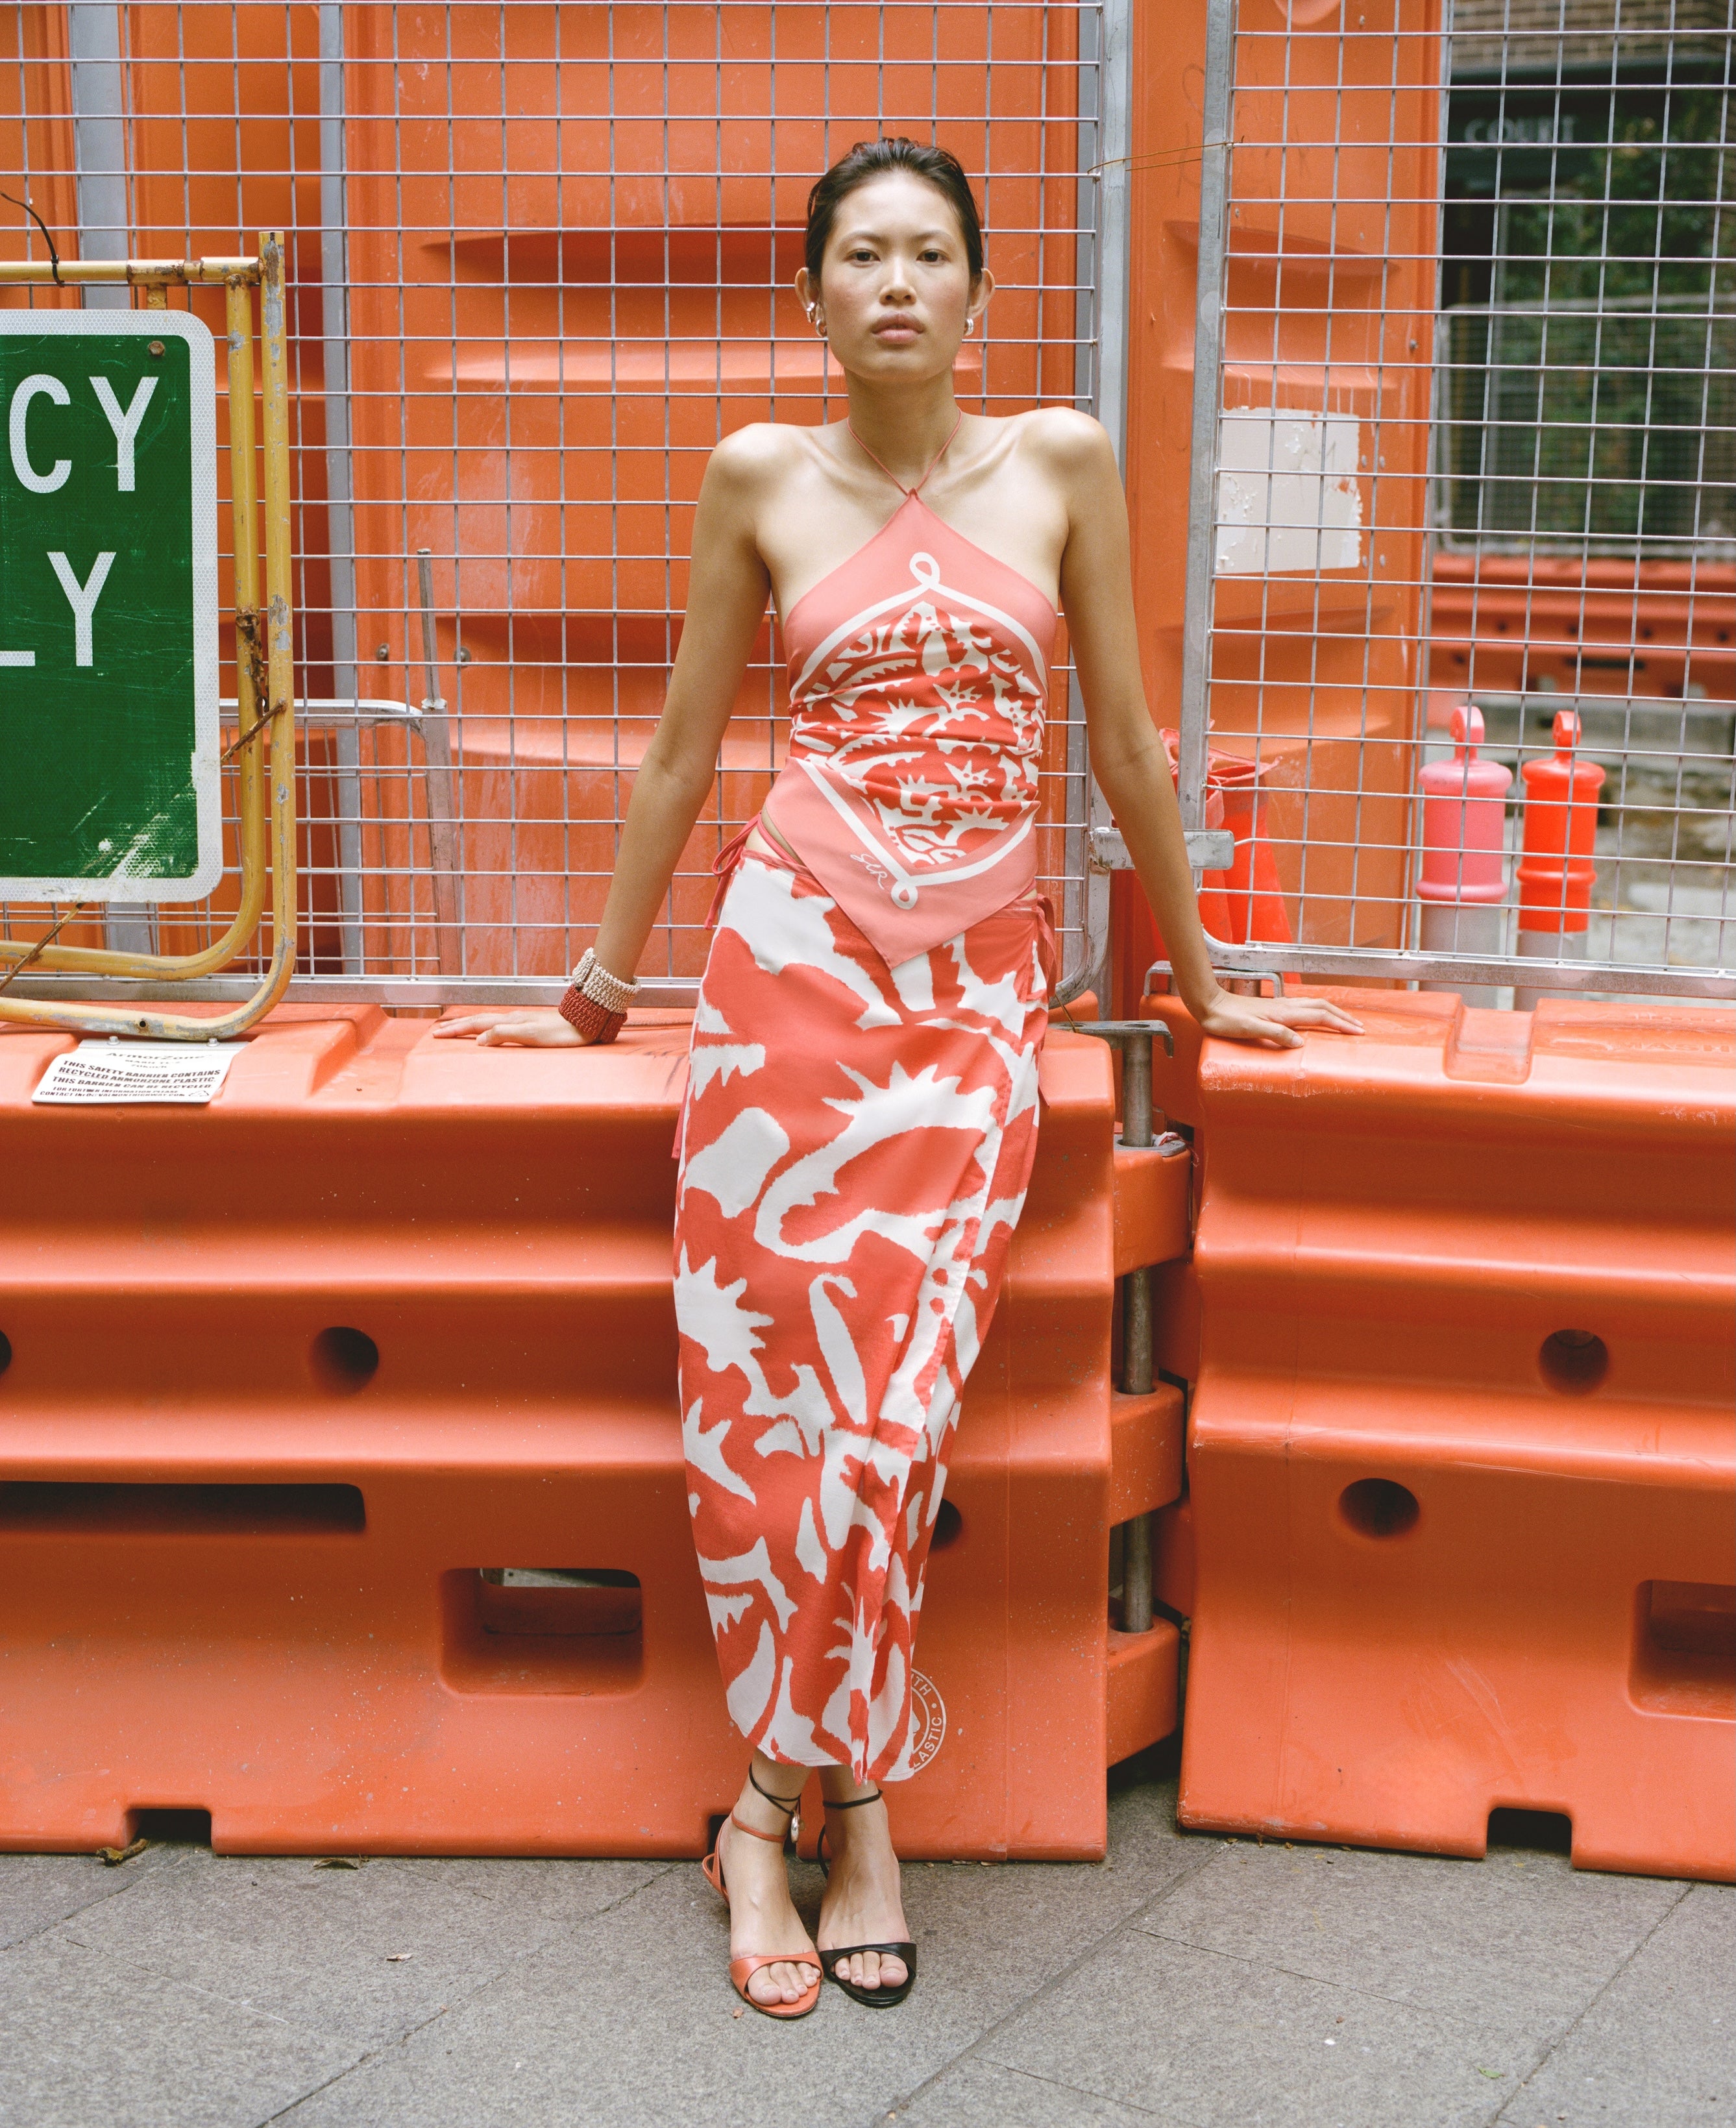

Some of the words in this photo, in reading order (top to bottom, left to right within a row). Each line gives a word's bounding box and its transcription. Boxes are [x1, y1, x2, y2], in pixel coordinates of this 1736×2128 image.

[9, 373, 160, 495] CY
[0, 551, 117, 667] Y
[58, 1067, 109, 1079] RECYCLED
[88, 1065, 124, 1075] SAFETY
[171, 1070, 221, 1078] CONTAINS
